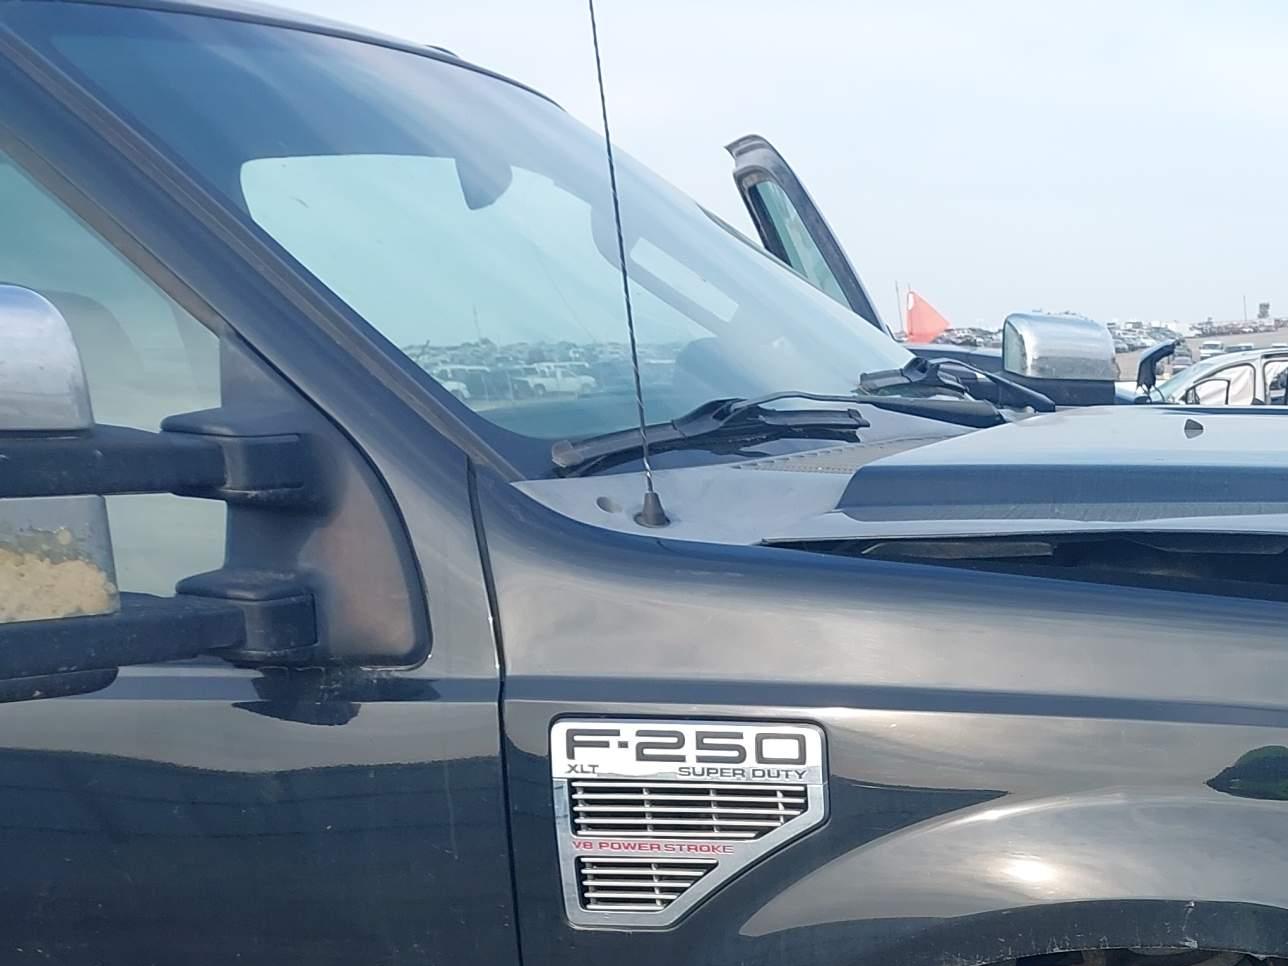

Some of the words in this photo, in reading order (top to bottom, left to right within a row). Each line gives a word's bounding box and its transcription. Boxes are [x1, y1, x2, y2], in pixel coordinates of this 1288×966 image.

[566, 728, 807, 766] F-250
[567, 764, 600, 775] XLT
[678, 766, 746, 779] SUPER
[751, 768, 808, 780] DUTY
